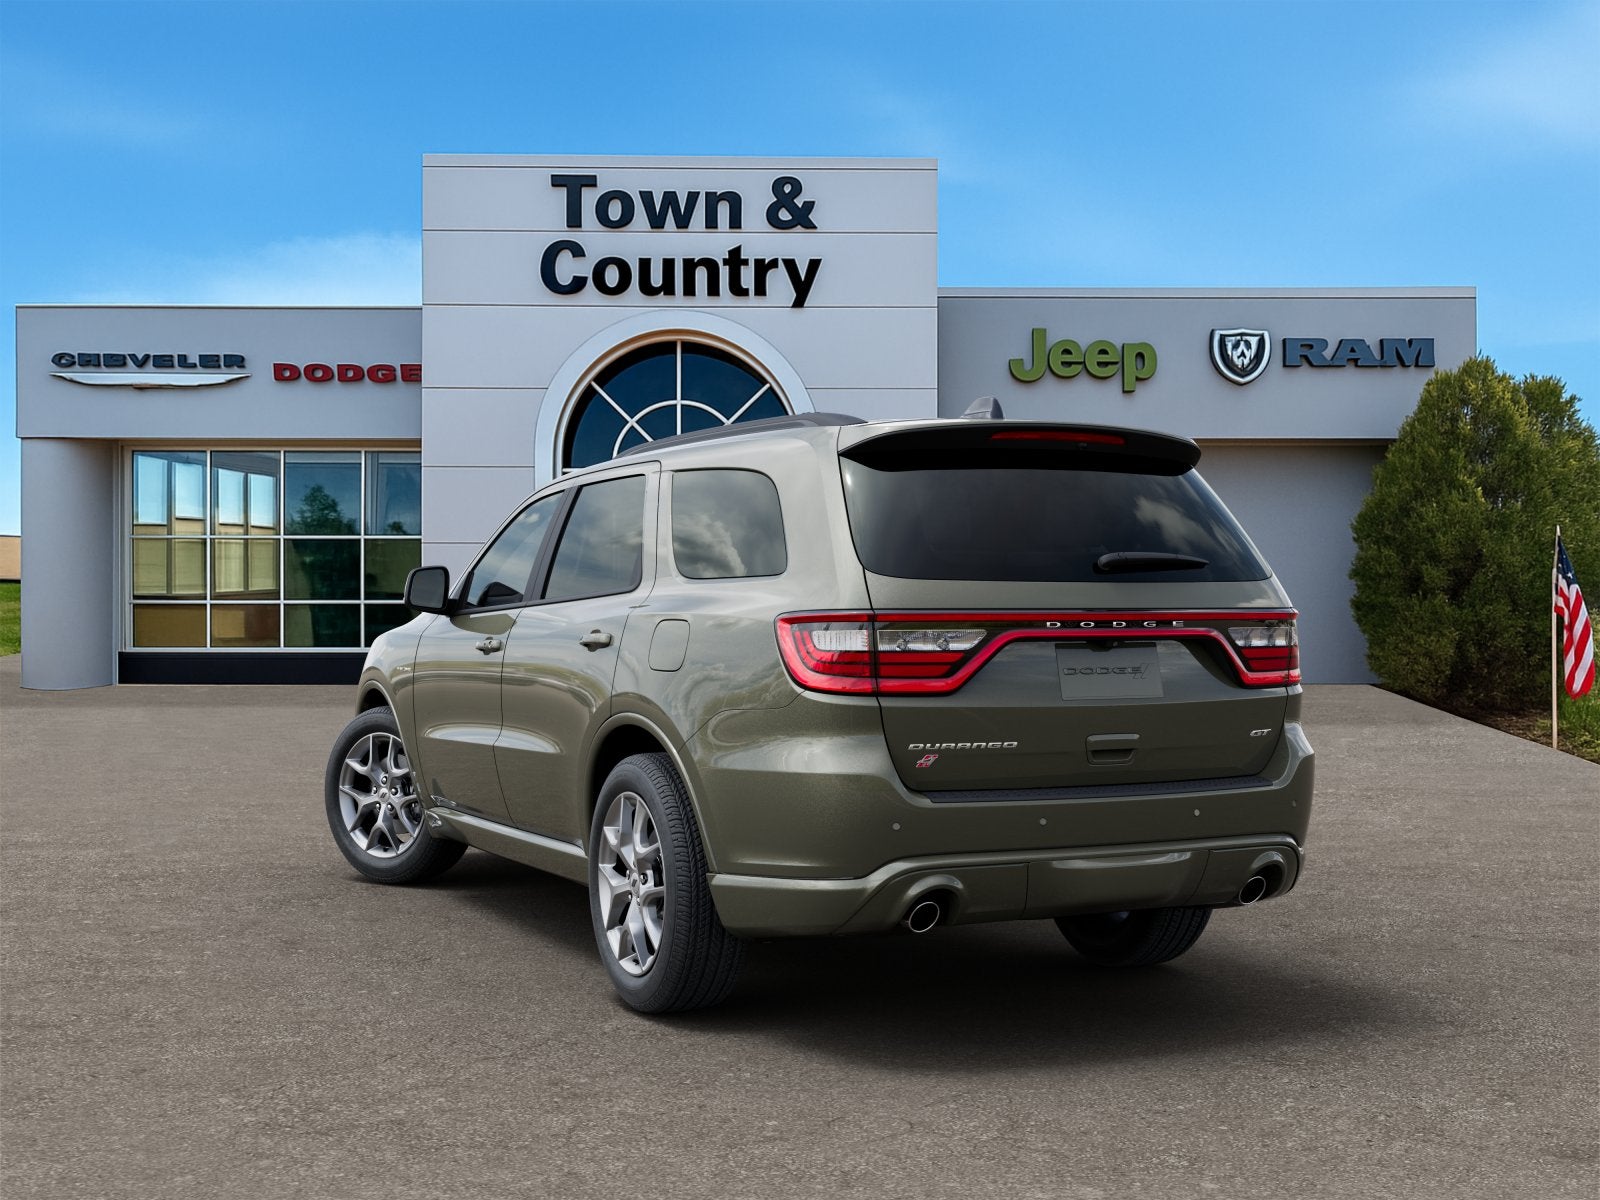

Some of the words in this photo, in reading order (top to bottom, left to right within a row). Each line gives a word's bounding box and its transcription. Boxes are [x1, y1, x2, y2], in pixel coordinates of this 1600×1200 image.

[551, 174, 742, 229] Town
[766, 176, 817, 229] &
[540, 240, 822, 308] Country
[1009, 328, 1157, 393] Jeep
[1283, 338, 1435, 367] RAM
[273, 363, 422, 383] DODGE
[1063, 666, 1143, 675] DODGE
[1250, 728, 1271, 737] GT
[908, 741, 1018, 750] DURANGO
